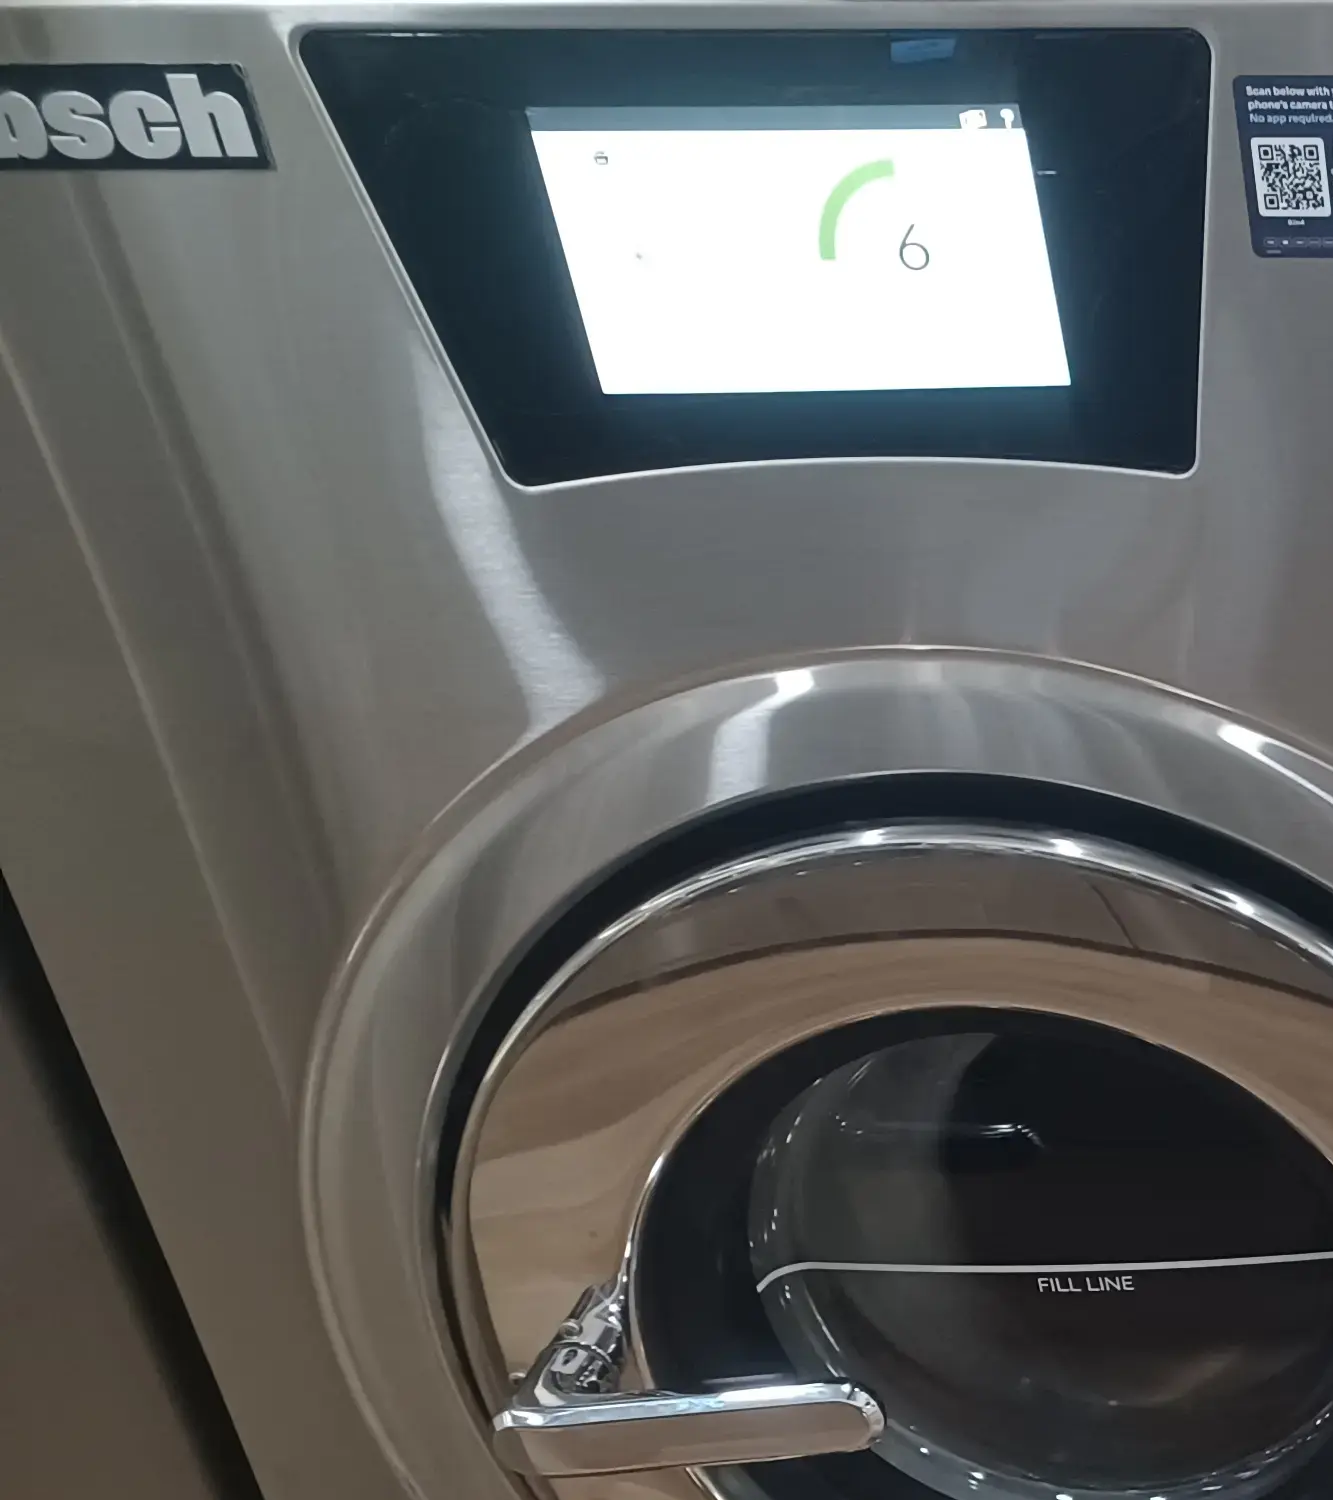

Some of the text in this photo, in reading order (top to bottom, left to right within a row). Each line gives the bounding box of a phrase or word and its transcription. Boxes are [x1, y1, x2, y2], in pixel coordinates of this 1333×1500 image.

[1246, 85, 1271, 97] Scan
[1273, 85, 1304, 96] below
[1306, 85, 1330, 96] with
[1248, 100, 1288, 112] phone's
[1289, 101, 1328, 110] camera
[1250, 114, 1266, 123] No
[1267, 115, 1287, 125] app
[899, 223, 930, 271] 6
[1037, 1275, 1135, 1293] FILL LINE
